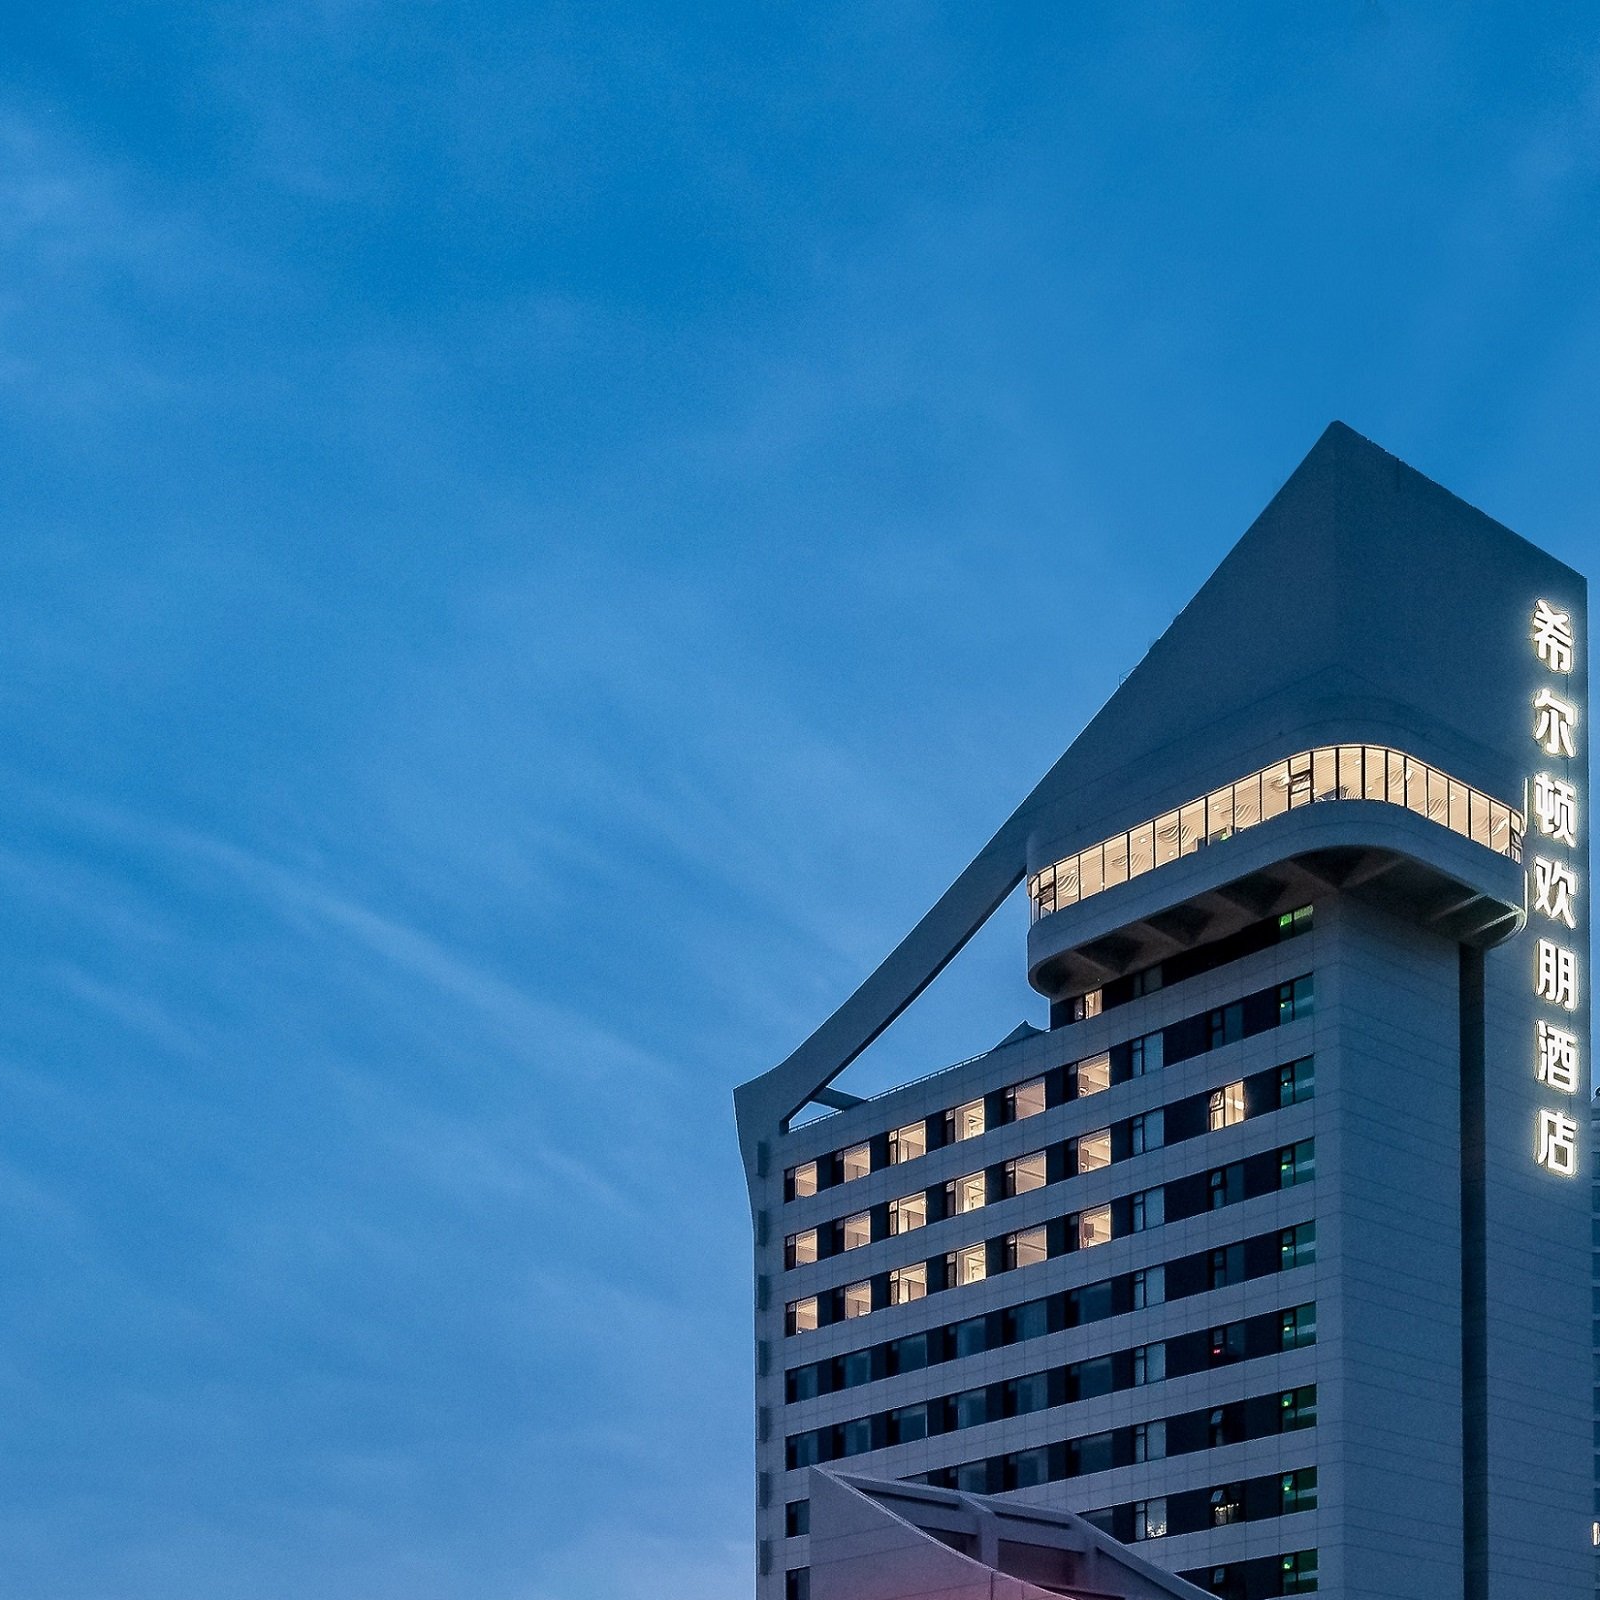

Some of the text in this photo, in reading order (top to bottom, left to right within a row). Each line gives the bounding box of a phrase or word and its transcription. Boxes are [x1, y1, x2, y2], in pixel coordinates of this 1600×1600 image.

[1532, 598, 1577, 1178] 希尔顿欢朋酒店
